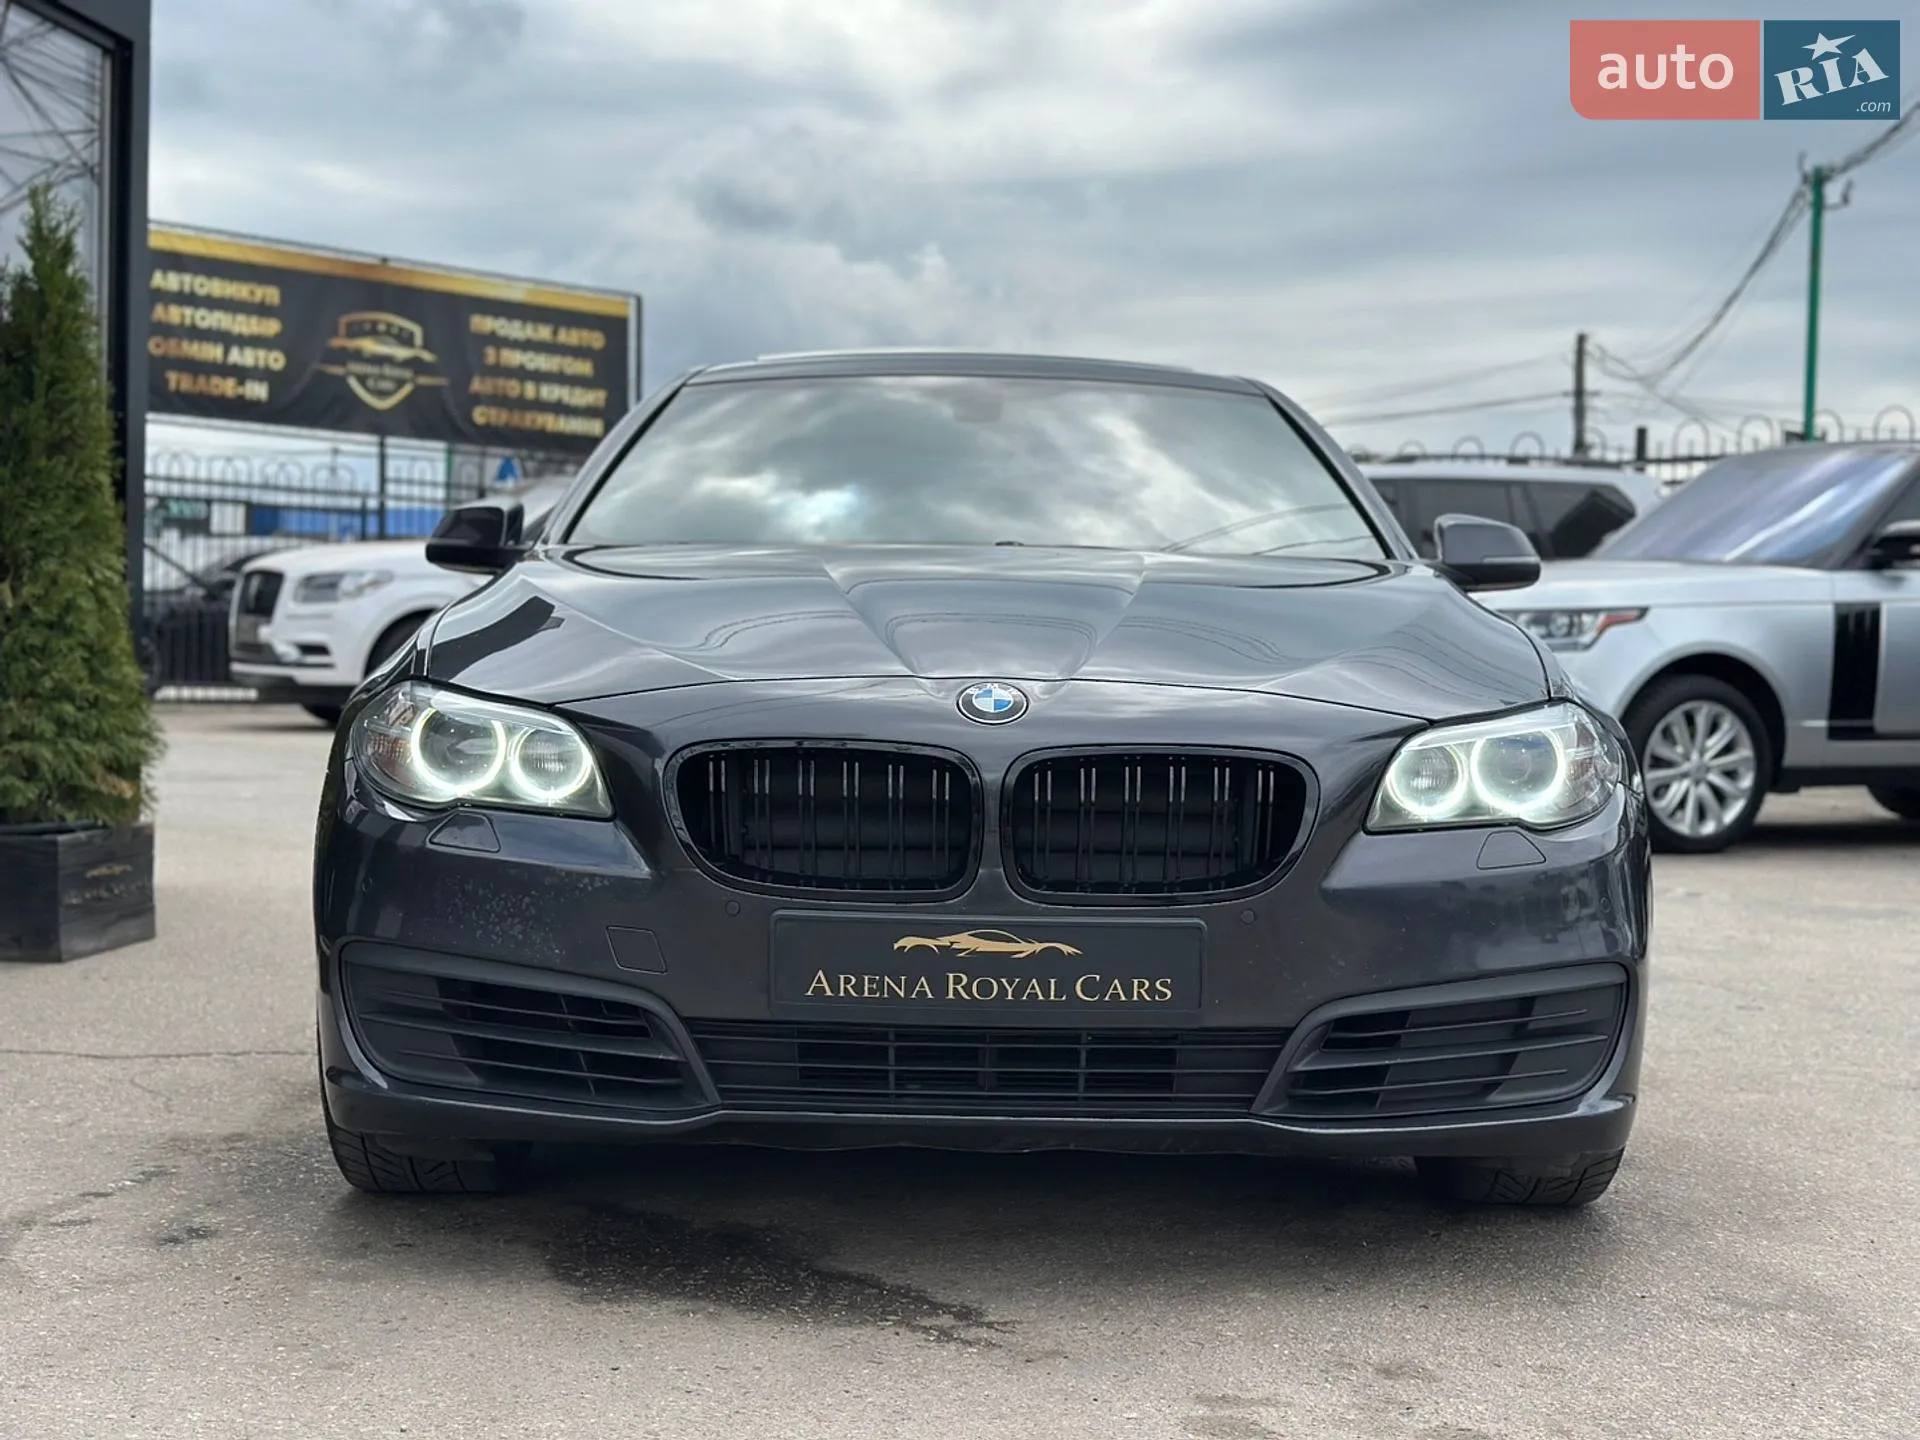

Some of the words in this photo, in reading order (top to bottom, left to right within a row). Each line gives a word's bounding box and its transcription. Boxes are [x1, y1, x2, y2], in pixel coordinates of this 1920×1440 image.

[150, 268, 281, 307] АВТОВИКУП
[556, 325, 606, 351] АВТО
[226, 344, 287, 371] АВТО
[164, 369, 269, 402] TRADE-IN
[805, 969, 934, 999] ARENA
[945, 973, 1066, 1001] ROYAL
[1075, 974, 1173, 1002] CARS
